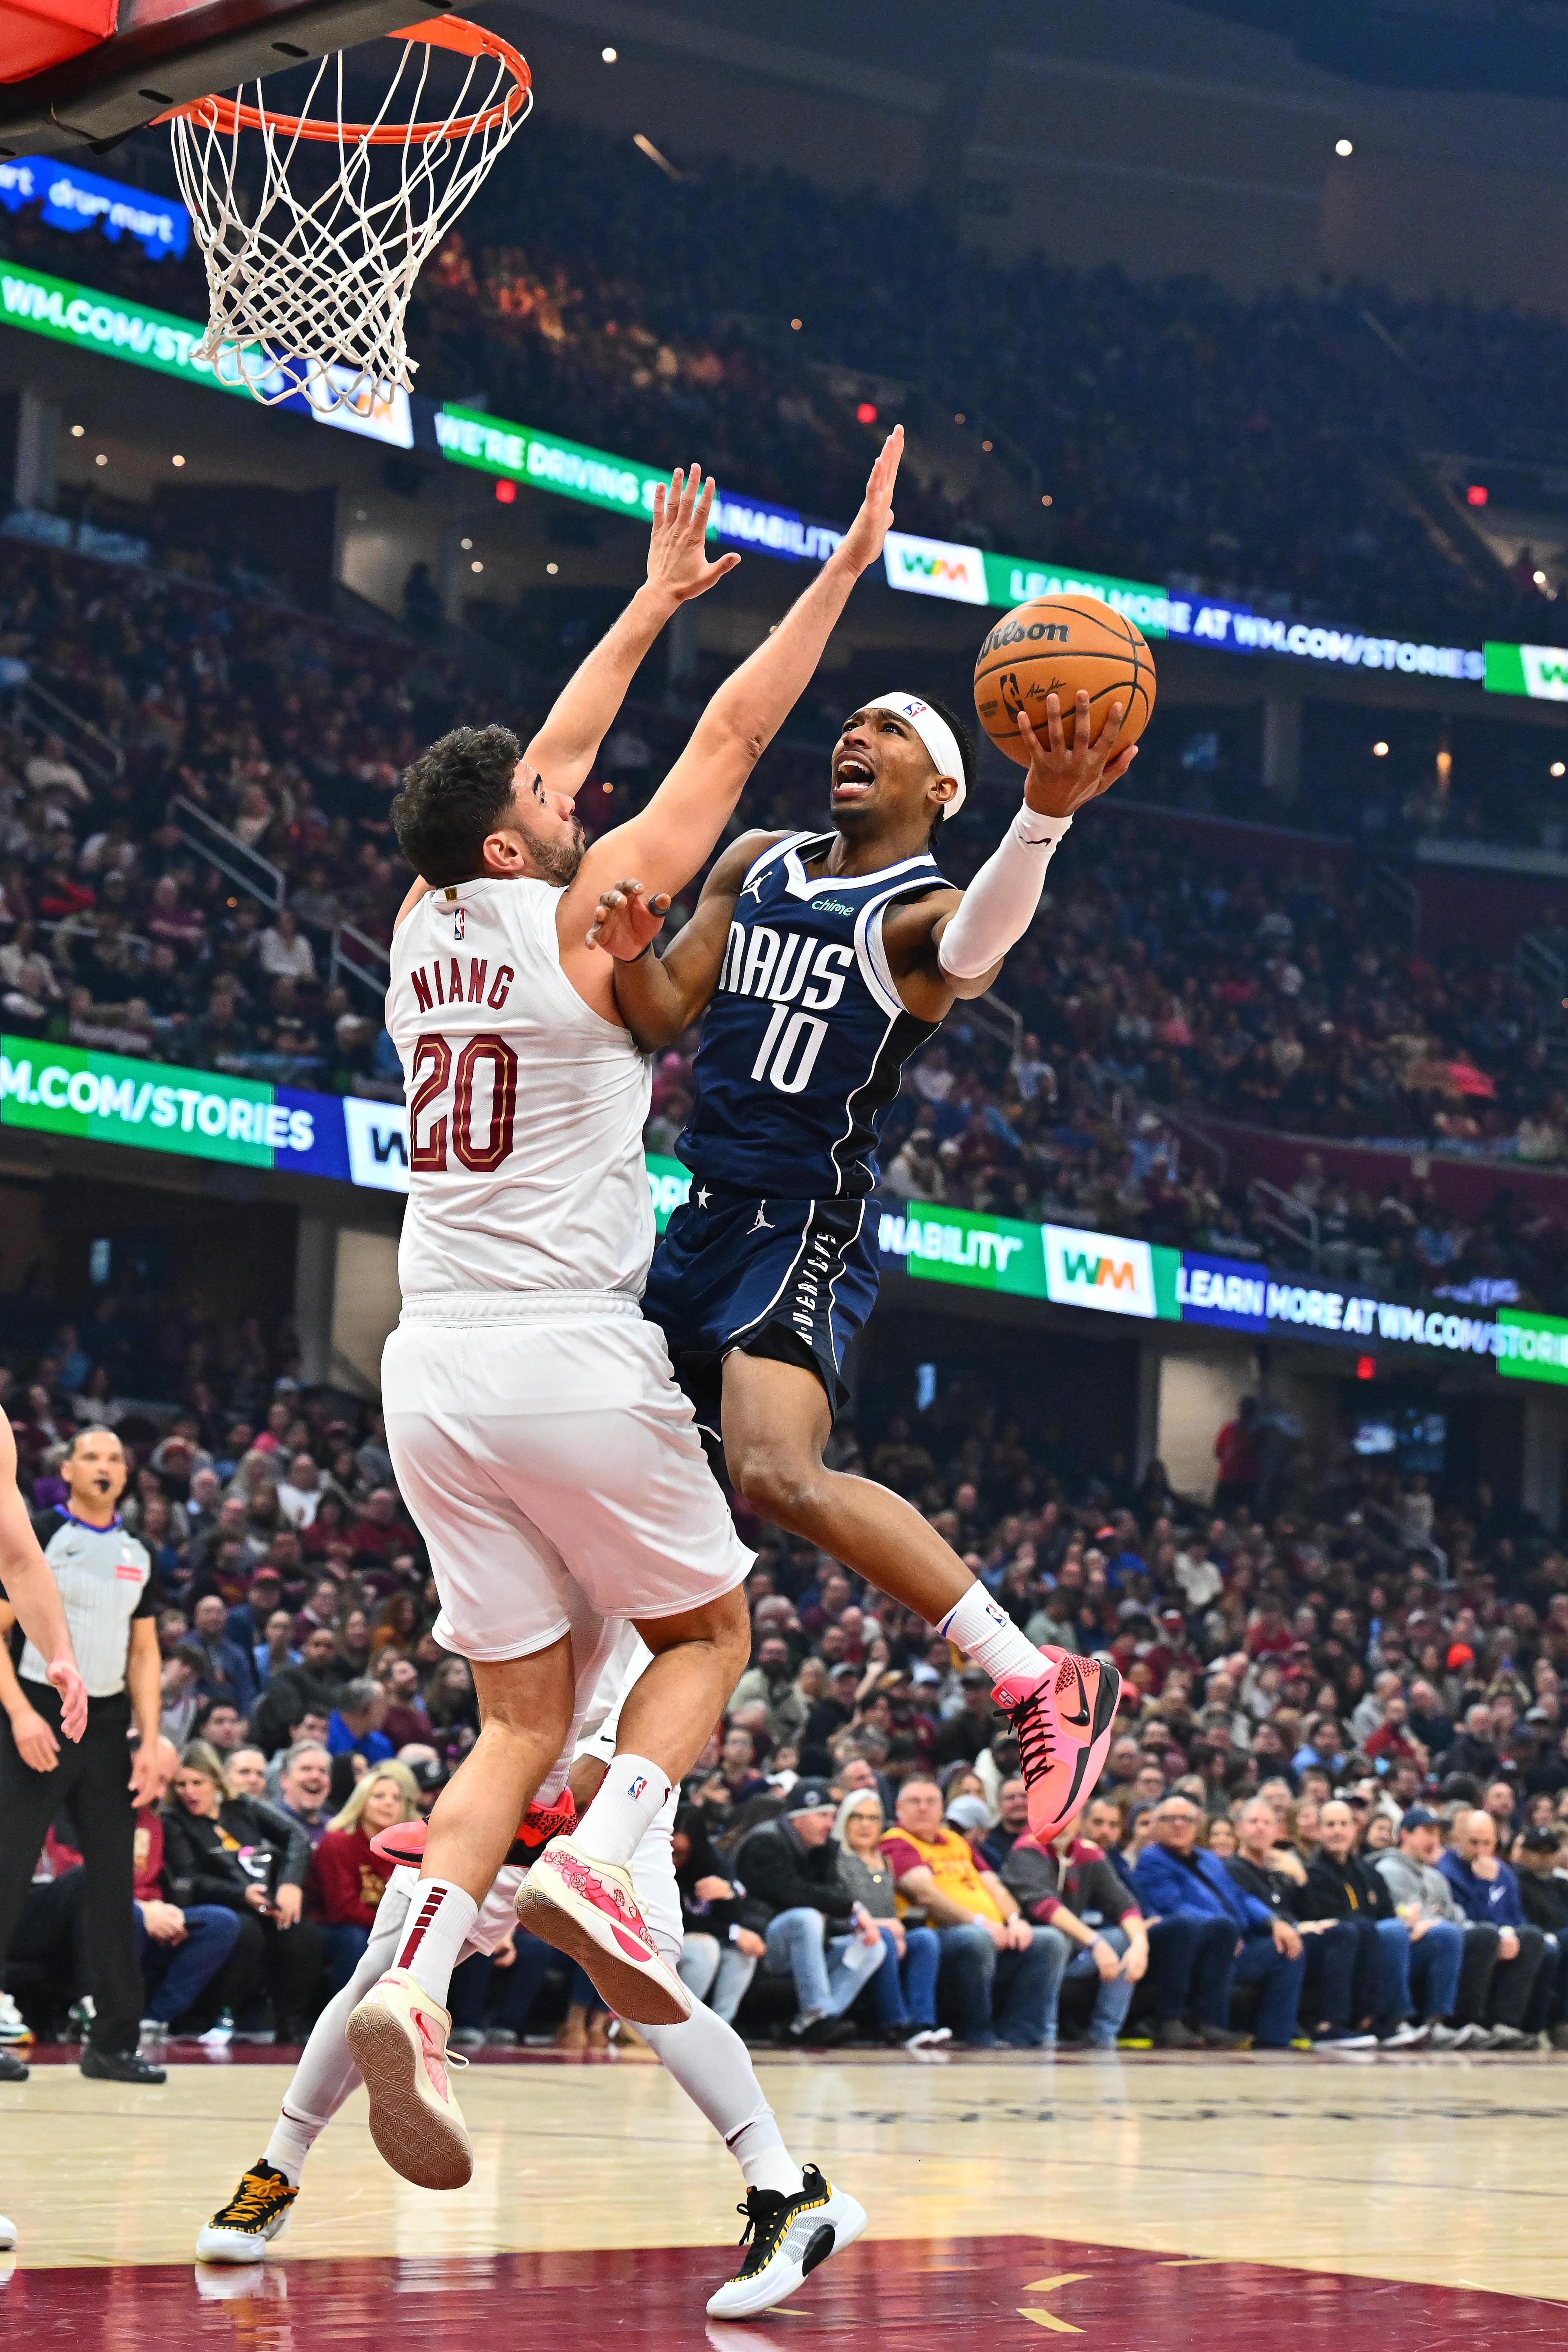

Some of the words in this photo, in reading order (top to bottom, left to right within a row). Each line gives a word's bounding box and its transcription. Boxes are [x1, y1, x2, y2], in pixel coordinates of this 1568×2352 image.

[527, 442, 639, 505] DRIVING
[903, 550, 968, 583] WM
[1109, 588, 1192, 634] MORE
[1193, 606, 1232, 640] AT
[811, 900, 854, 917] chime
[411, 958, 514, 1013] NIANG
[751, 1002, 829, 1093] 10
[411, 1033, 518, 1172] 20
[1063, 1250, 1135, 1291] WM
[1176, 1267, 1265, 1316] LEARN
[1265, 1283, 1344, 1330] MORE
[1343, 1297, 1378, 1334] AT
